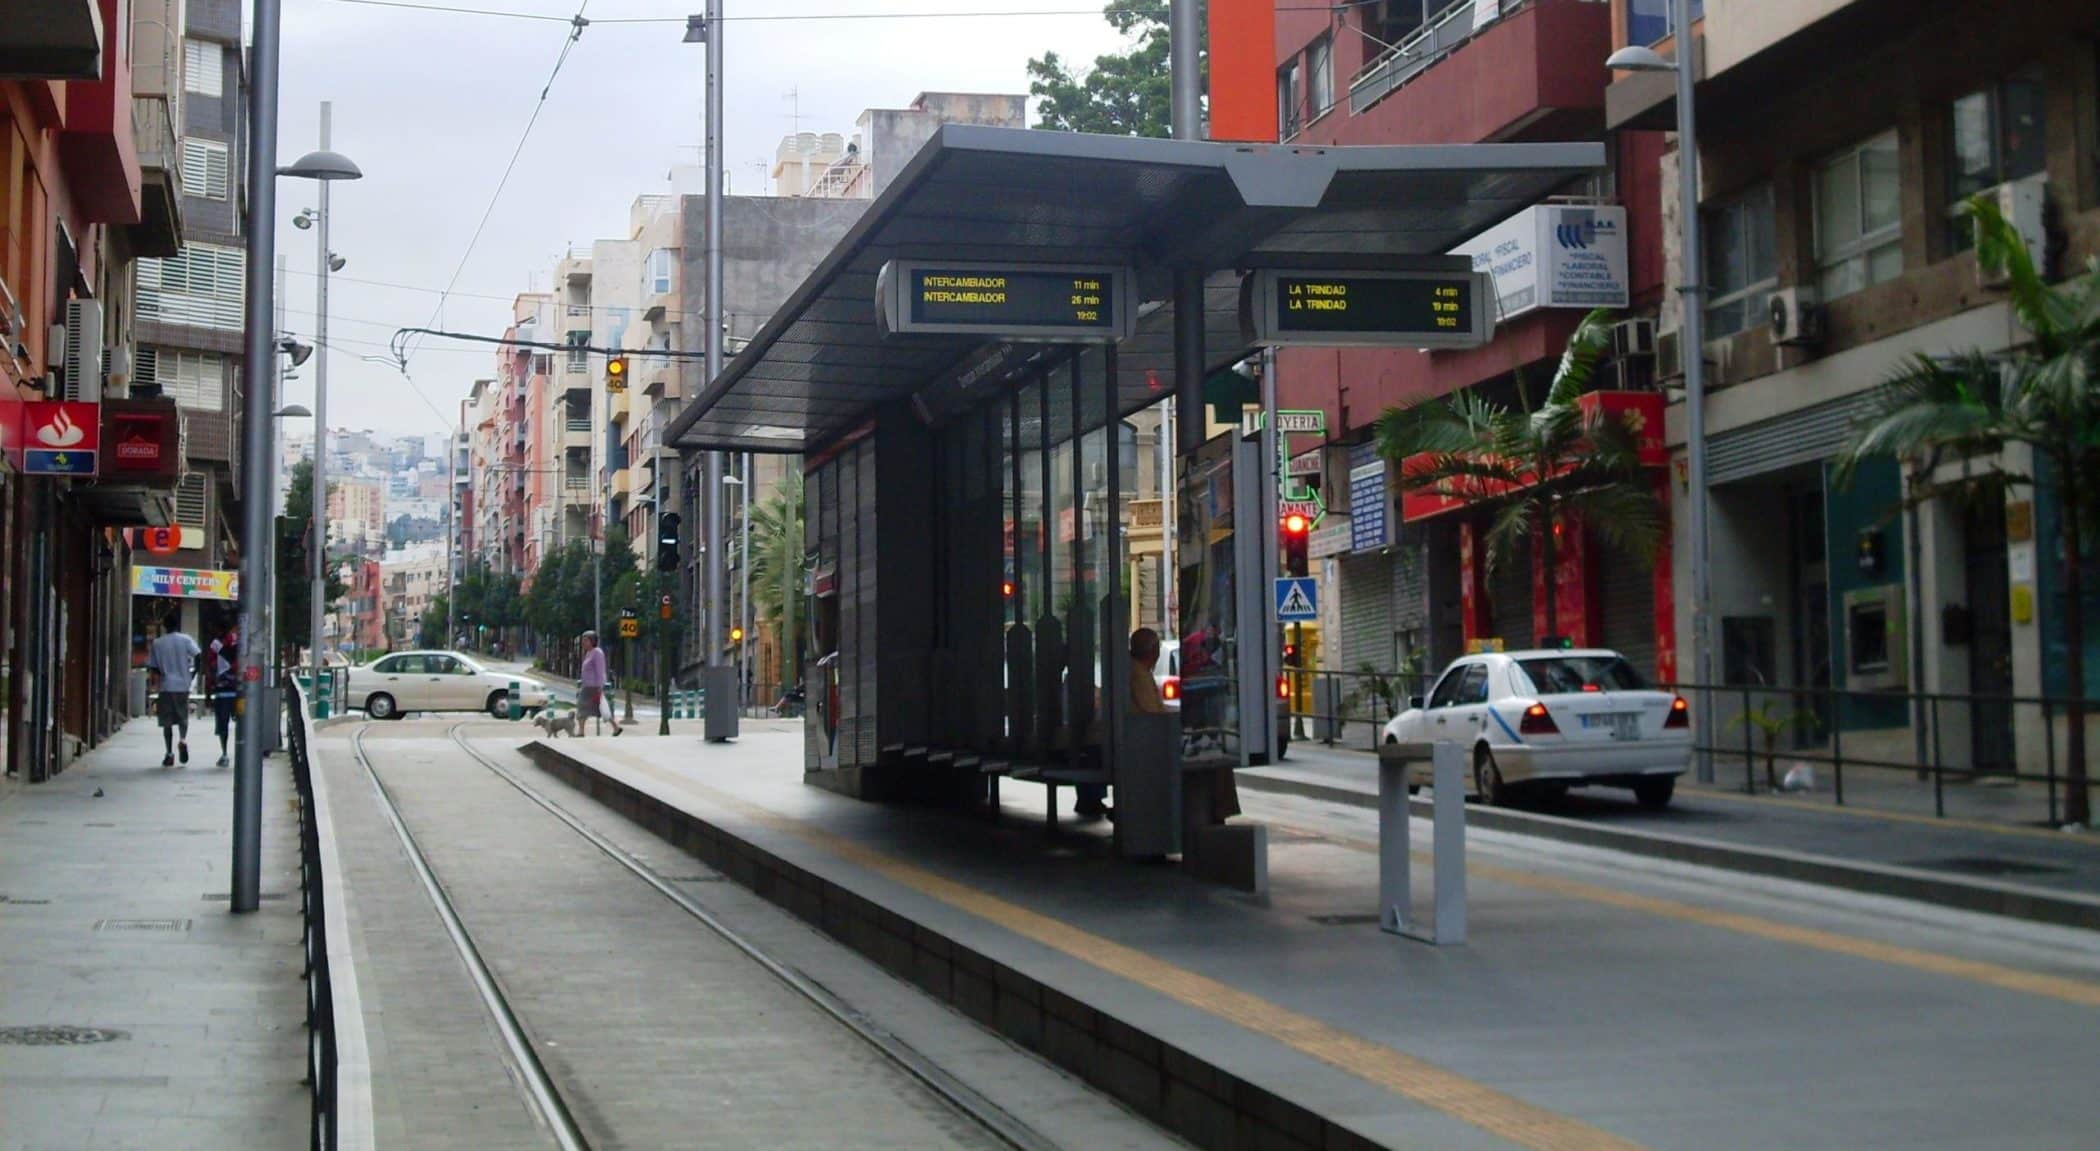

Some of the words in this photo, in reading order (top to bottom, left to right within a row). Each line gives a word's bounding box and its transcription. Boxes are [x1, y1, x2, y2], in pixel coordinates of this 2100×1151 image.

[924, 276, 1005, 289] INTERCAMBIADOR
[1073, 280, 1082, 289] 11
[1083, 279, 1099, 289] min
[1288, 284, 1301, 296] LA
[1306, 284, 1346, 297] TRINIDAD
[1435, 287, 1441, 296] 4
[1442, 287, 1458, 296] min
[924, 292, 1005, 304] INTERCAMBIADOR
[1083, 294, 1100, 305] min
[1289, 299, 1302, 310] LA
[1307, 299, 1347, 311] TRINIDAD
[1442, 301, 1459, 311] min
[1276, 415, 1319, 429] OYERIA
[621, 623, 637, 633] 40
